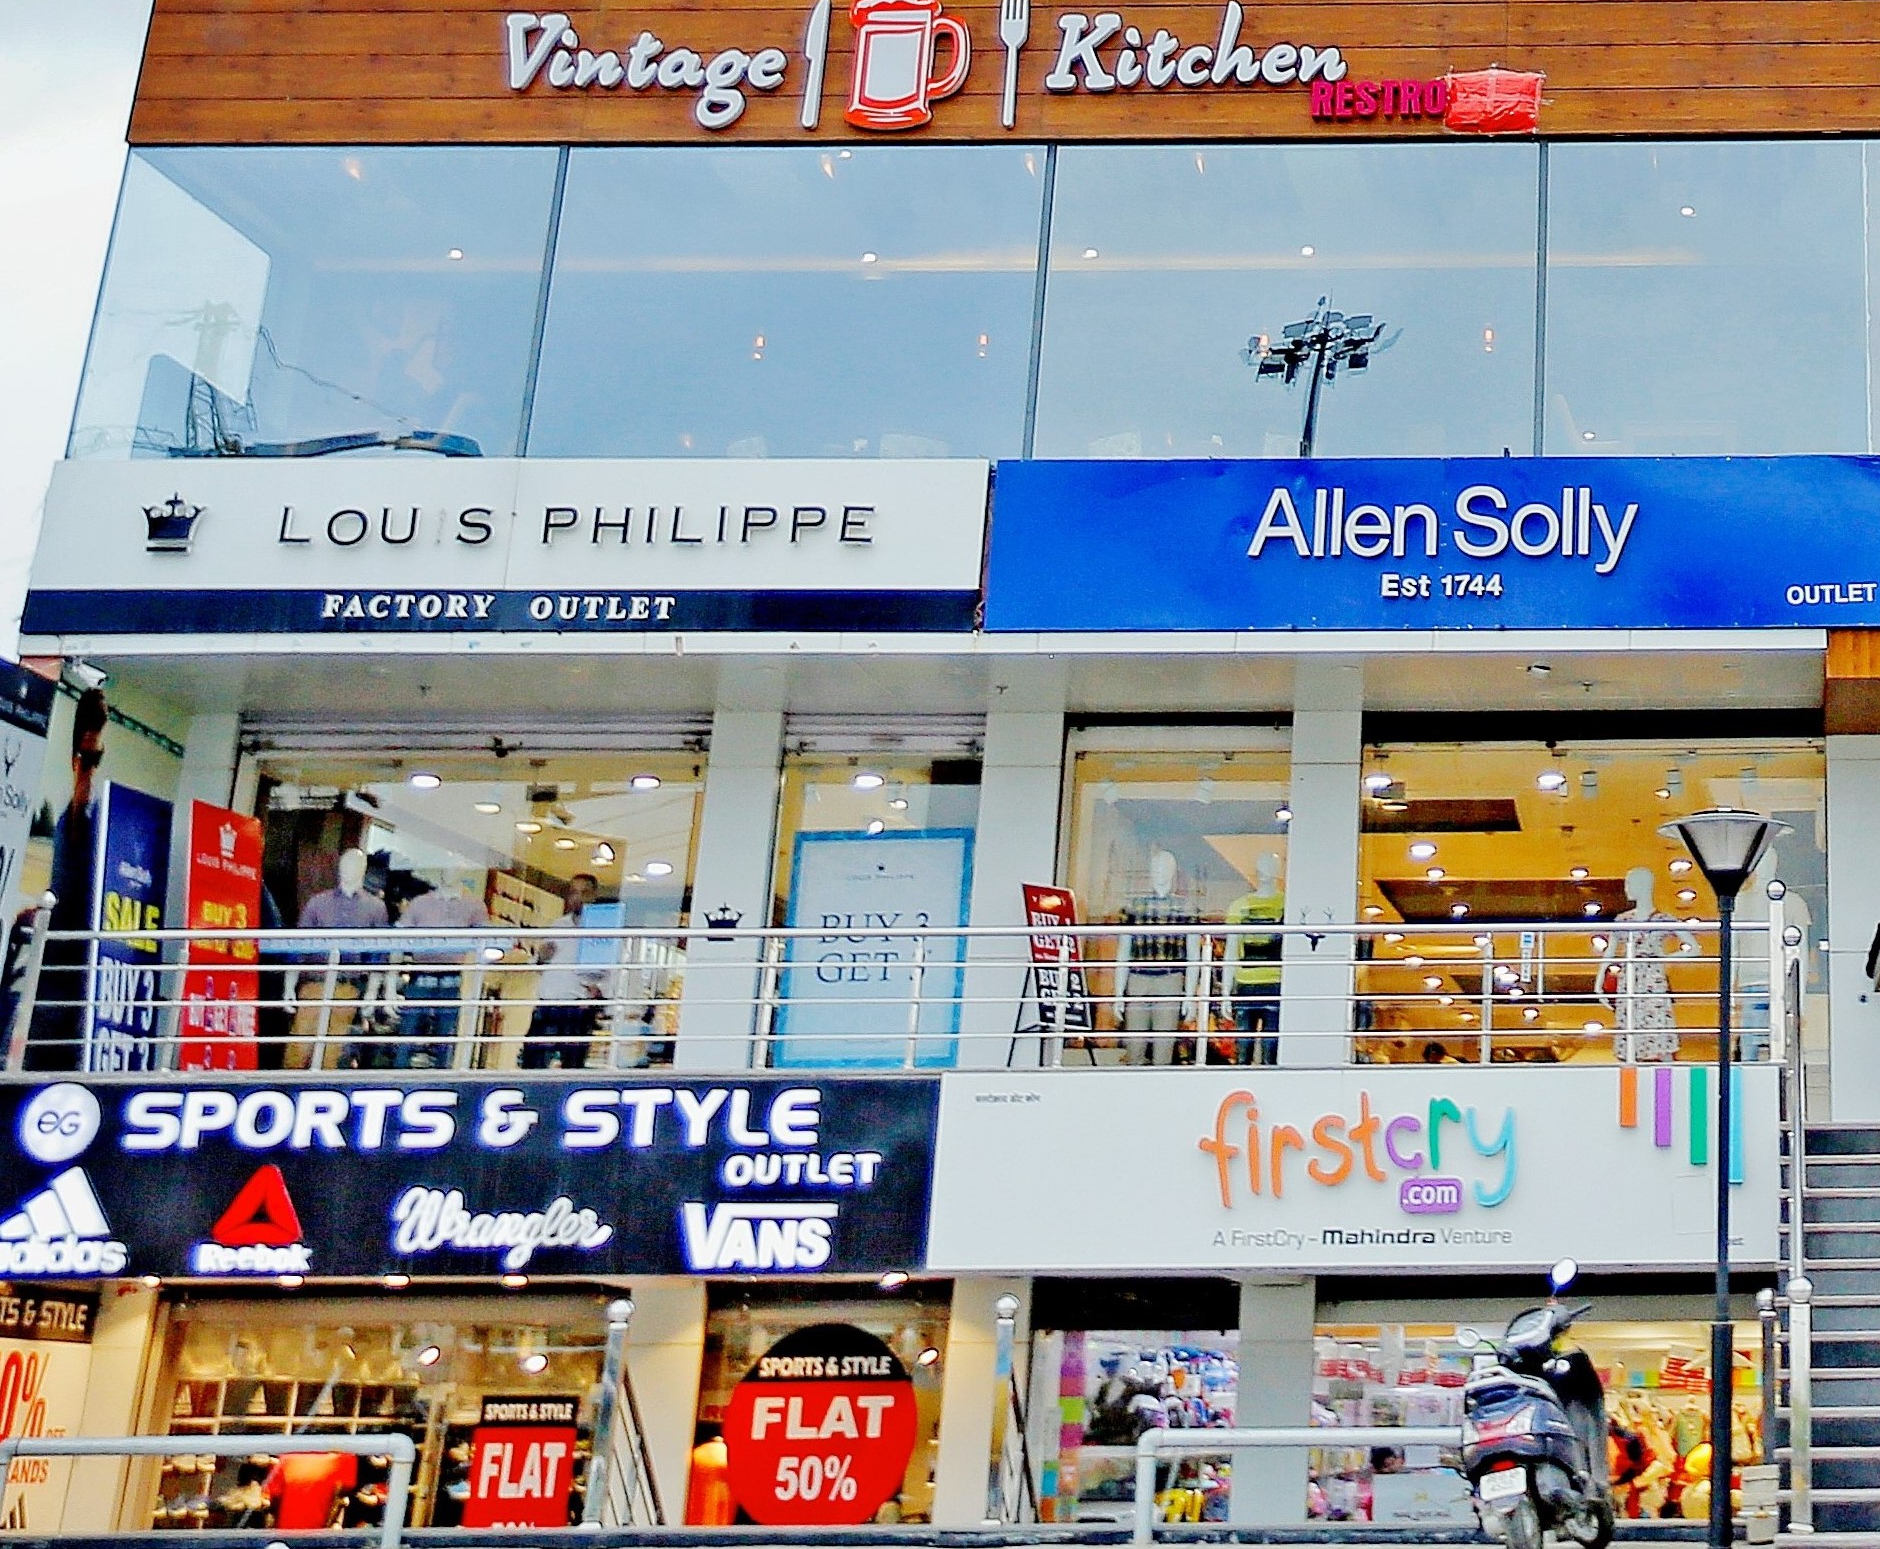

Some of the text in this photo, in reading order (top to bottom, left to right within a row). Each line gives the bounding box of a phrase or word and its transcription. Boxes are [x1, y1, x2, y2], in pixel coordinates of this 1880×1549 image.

[505, 11, 789, 130] Vintage
[1311, 79, 1447, 121] RESTRO
[278, 505, 878, 547] LOUS PHILIPPE
[1246, 485, 1639, 574] Allen Solly
[1380, 573, 1503, 598] Est 1744
[1785, 582, 1878, 605] OUTLET
[321, 593, 676, 620] FACTORY OUTLET
[819, 913, 902, 943] BUY
[816, 951, 899, 983] GET
[100, 956, 141, 1027] BUY
[124, 1088, 821, 1149] SPORTS & STYLE
[1198, 1089, 1518, 1210] firstcry
[723, 1153, 882, 1186] OUTLET
[1402, 1183, 1458, 1205] .com
[396, 1185, 613, 1269] Wrangler
[682, 1201, 840, 1270] VANS
[1212, 1230, 1227, 1246] A
[1231, 1228, 1305, 1250] FirstCry
[1322, 1229, 1436, 1246] Mahindra
[1440, 1227, 1513, 1246] Venture
[197, 1242, 313, 1273] Reebok
[36, 1300, 88, 1332] STYLE
[759, 1355, 892, 1378] SPORTS & STYLE
[484, 1403, 528, 1421] SPORTS
[539, 1402, 574, 1421] STYLE
[751, 1395, 895, 1440] FLAT
[477, 1441, 567, 1499] FLAT
[775, 1454, 858, 1502] 50%
